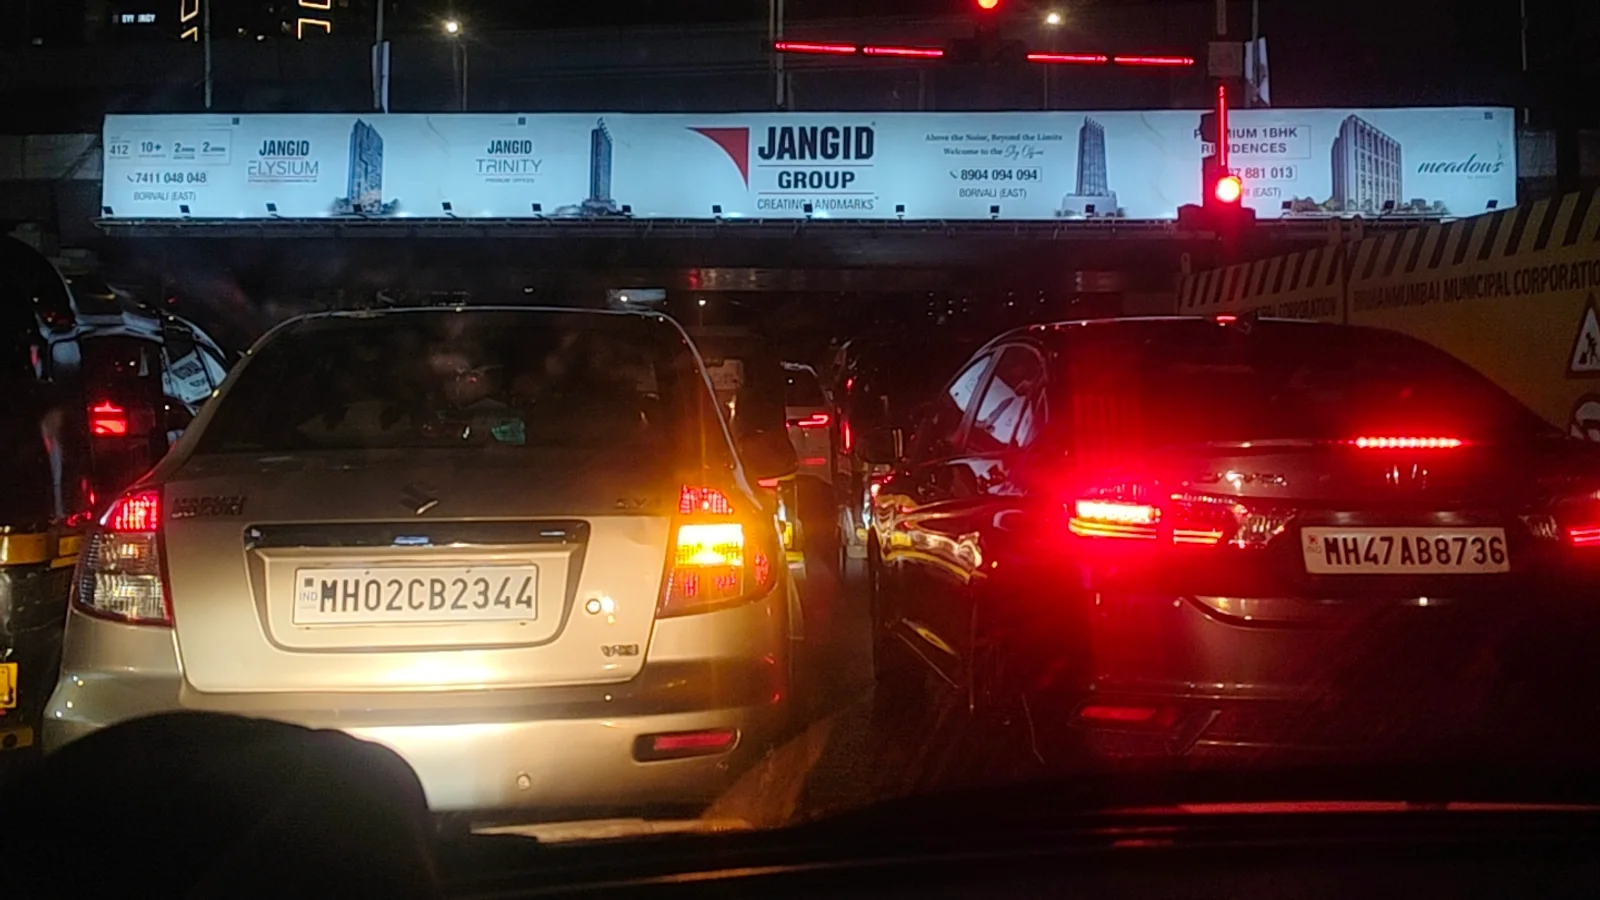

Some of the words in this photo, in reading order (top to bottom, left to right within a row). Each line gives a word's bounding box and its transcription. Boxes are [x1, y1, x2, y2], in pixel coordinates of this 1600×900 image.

[991, 134, 1020, 143] Beyond
[1037, 133, 1063, 141] Limits
[1262, 127, 1298, 138] 1BHK
[109, 144, 129, 155] 412
[259, 140, 310, 156] JANGID
[487, 140, 532, 155] JANGID
[758, 126, 874, 160] JANGID
[943, 147, 979, 155] Welcome
[990, 147, 1003, 155] the
[248, 160, 319, 175] ELYSIUM
[475, 159, 543, 173] TRINITY
[1417, 153, 1504, 174] meadows
[135, 172, 160, 184] 7411
[163, 172, 184, 184] 048
[186, 172, 207, 183] 048
[961, 169, 988, 180] 8904
[991, 169, 1013, 180] 094
[1016, 169, 1038, 180] 094
[1245, 167, 1266, 179] 881
[1270, 167, 1293, 179] 013
[778, 171, 855, 189] GROUP
[133, 191, 169, 201] BORIVALI
[170, 191, 197, 201] (EAST)
[959, 188, 997, 198] BORIVALI
[999, 188, 1027, 199] (EAST)
[1253, 187, 1282, 198] (EAST)
[1443, 270, 1510, 301] MUNICIPAL
[1324, 535, 1505, 566] MH47AB8736
[299, 591, 318, 601] IND
[319, 576, 534, 613] MH02CB2344
